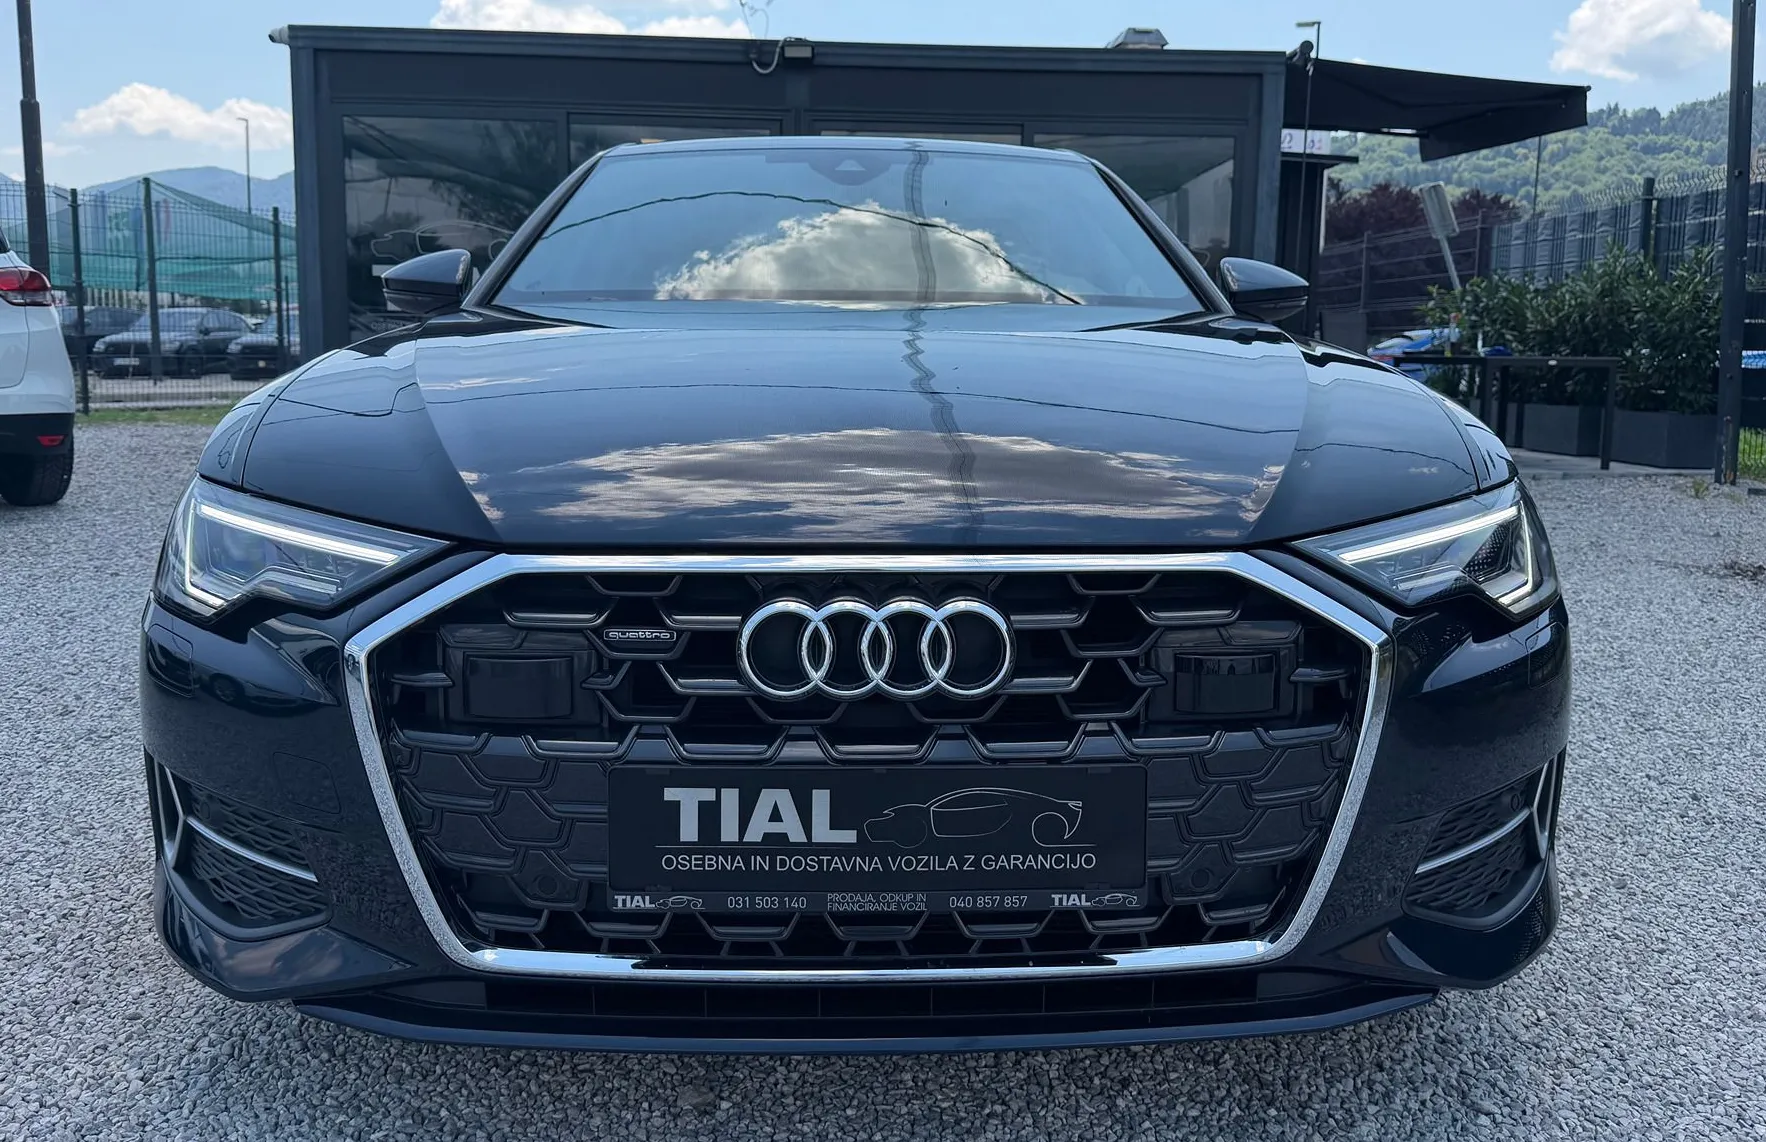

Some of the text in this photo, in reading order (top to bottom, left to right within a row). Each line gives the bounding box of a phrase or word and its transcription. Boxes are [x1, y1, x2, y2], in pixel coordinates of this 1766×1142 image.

[609, 631, 670, 639] quattro
[664, 787, 857, 843] TIAL
[661, 853, 1096, 872] OSEBNA IN DOSTAVNA VOZILA Z GARANCIJO
[614, 895, 655, 908] TIAL
[727, 896, 807, 909] 031 503 140
[827, 893, 926, 903] PRODAJA, ODKUP IN
[949, 895, 1028, 908] 040 857 857
[1051, 894, 1091, 906] TIAL
[827, 902, 927, 911] FINANCIRANJE VOZIL
